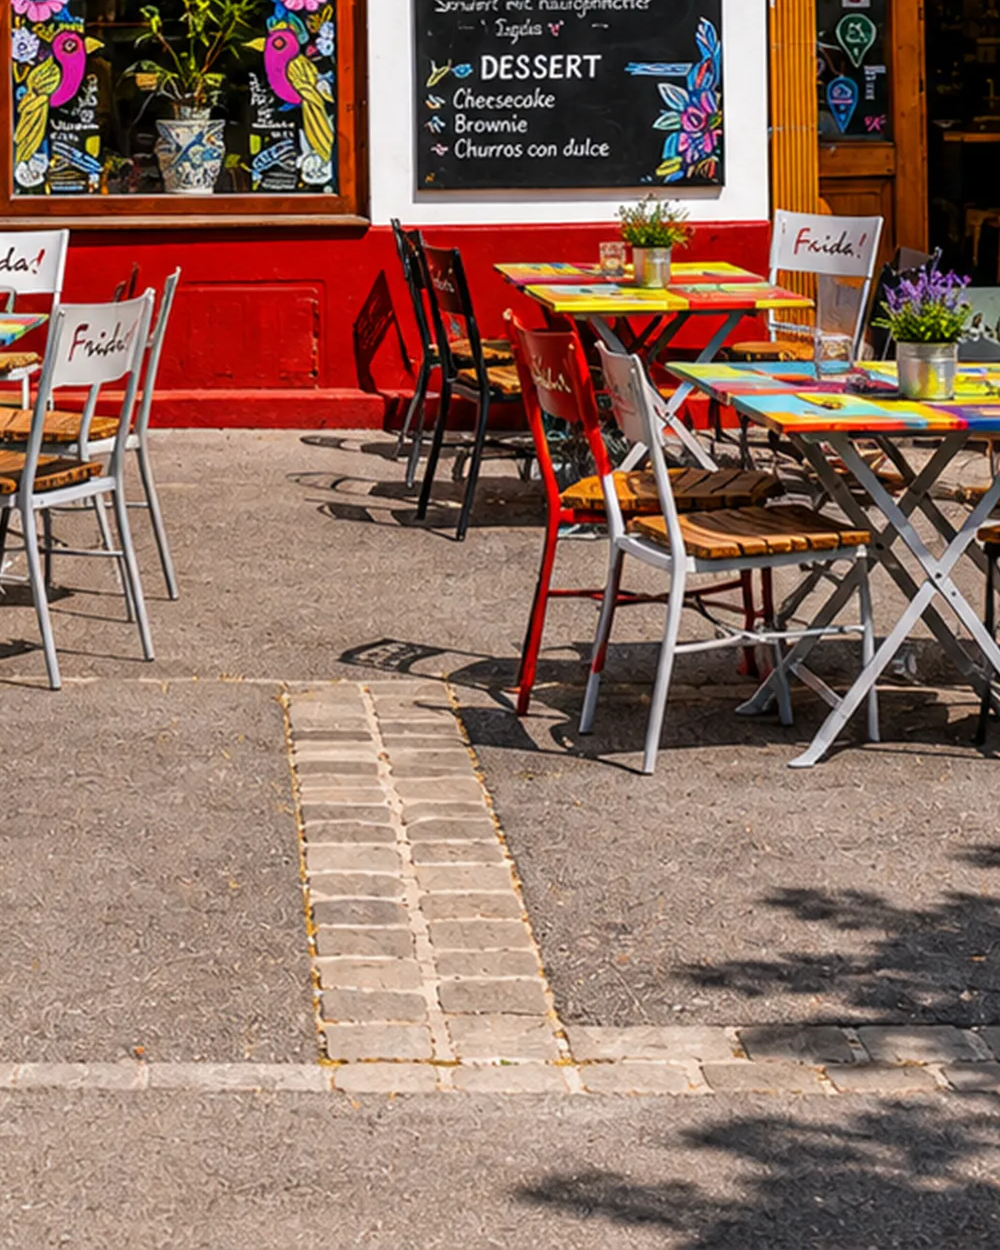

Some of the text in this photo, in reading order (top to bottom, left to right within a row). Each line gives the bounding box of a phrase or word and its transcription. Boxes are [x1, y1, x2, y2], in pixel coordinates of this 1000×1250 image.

[481, 54, 602, 80] DESSERT
[453, 87, 555, 110] Cheesecake
[454, 113, 528, 134] Brownie
[454, 137, 610, 159] Churros con dulce
